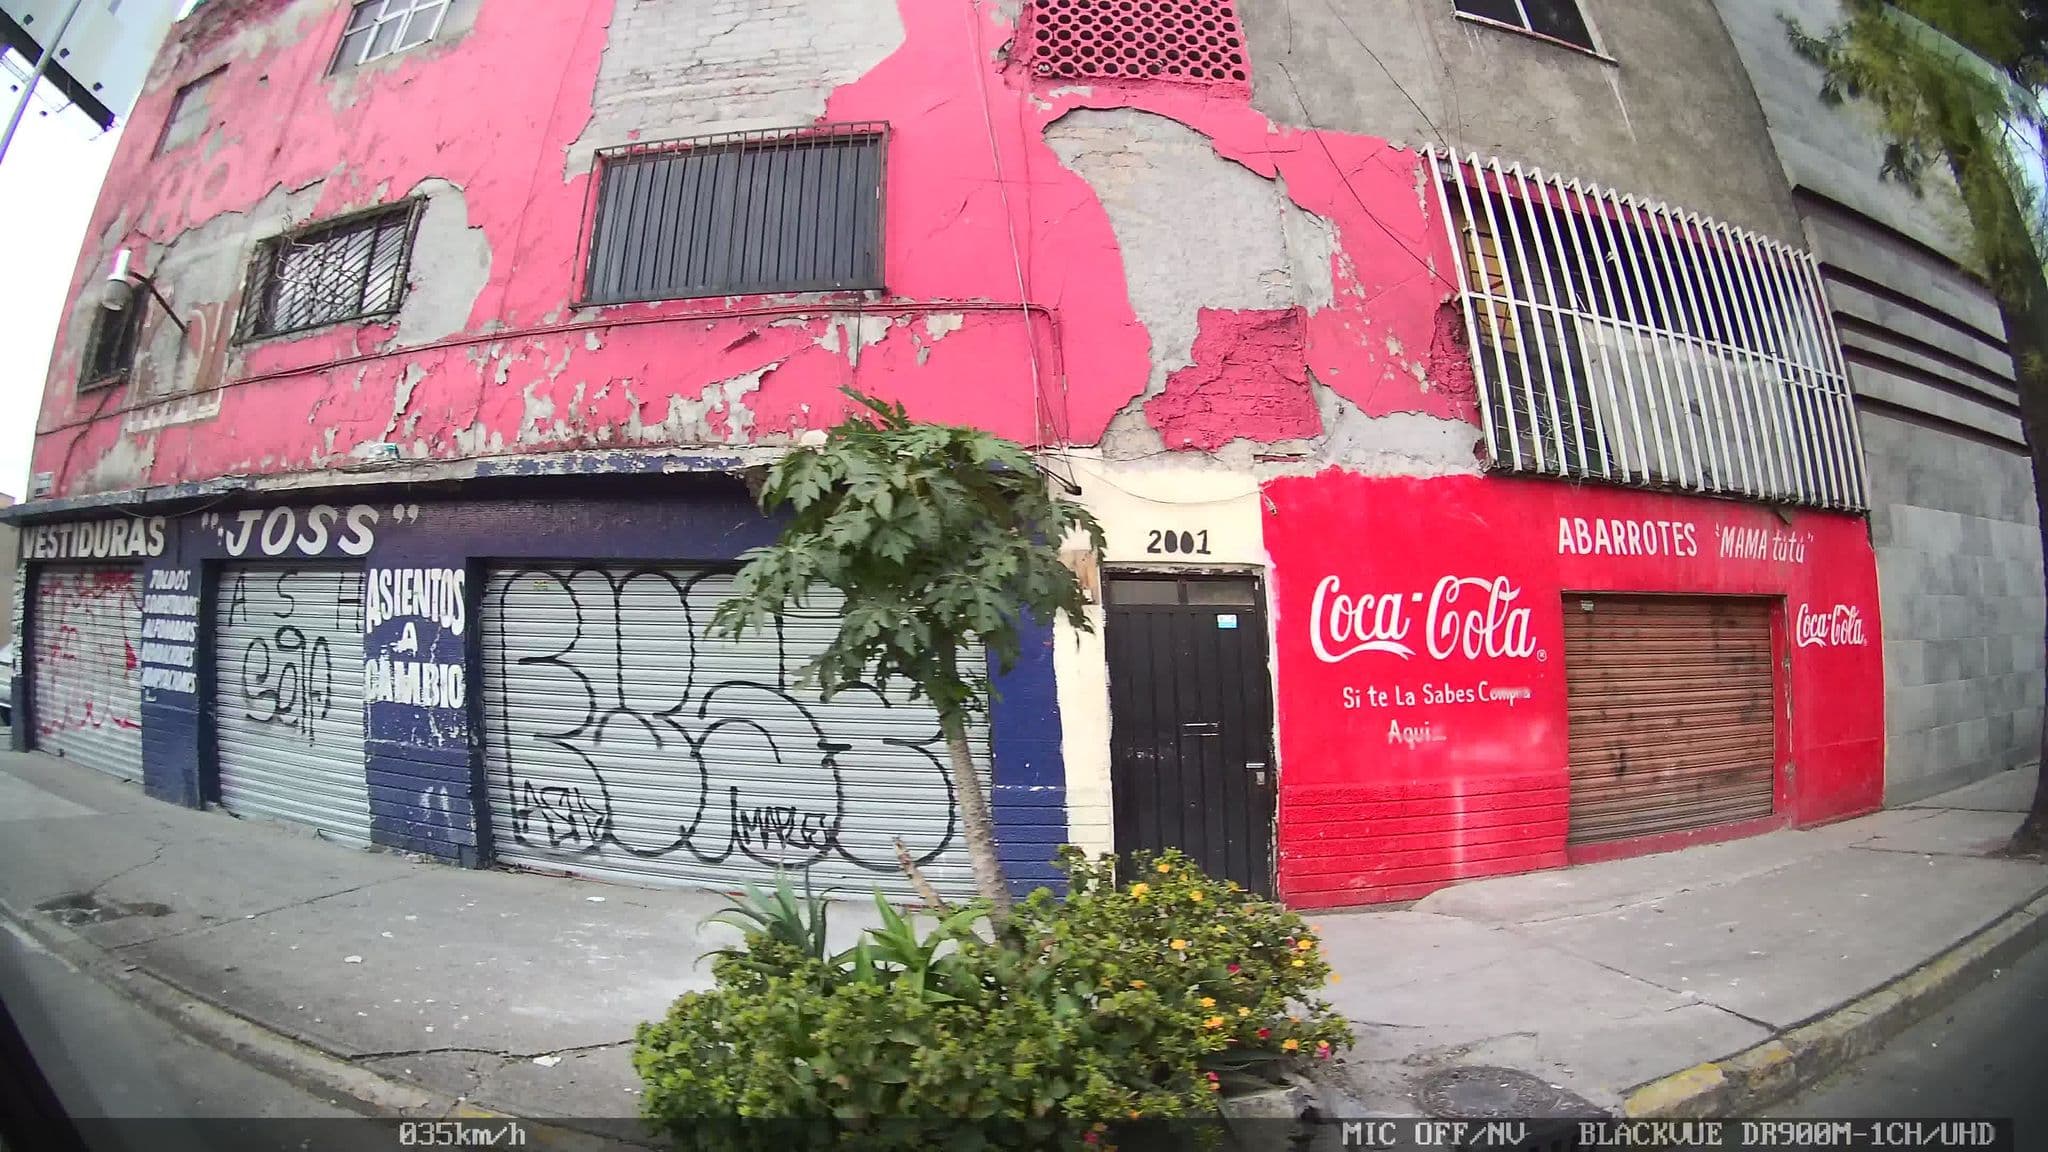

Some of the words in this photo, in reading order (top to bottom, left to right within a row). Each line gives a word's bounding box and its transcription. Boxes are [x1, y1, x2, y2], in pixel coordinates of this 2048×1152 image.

[22, 516, 165, 558] VESTIDURAS
[1147, 529, 1211, 555] 2001
[1558, 517, 1697, 557] ABARROTES
[366, 568, 465, 636] ASIENTOS
[1310, 575, 1536, 663] Coca-Cola
[400, 622, 418, 657] A
[1796, 603, 1864, 647] Coca-Cola
[365, 657, 466, 709] CAMBIO
[1343, 686, 1361, 709] Si
[1367, 685, 1388, 707] te
[1395, 685, 1416, 706] La
[1423, 683, 1475, 704] Sabes
